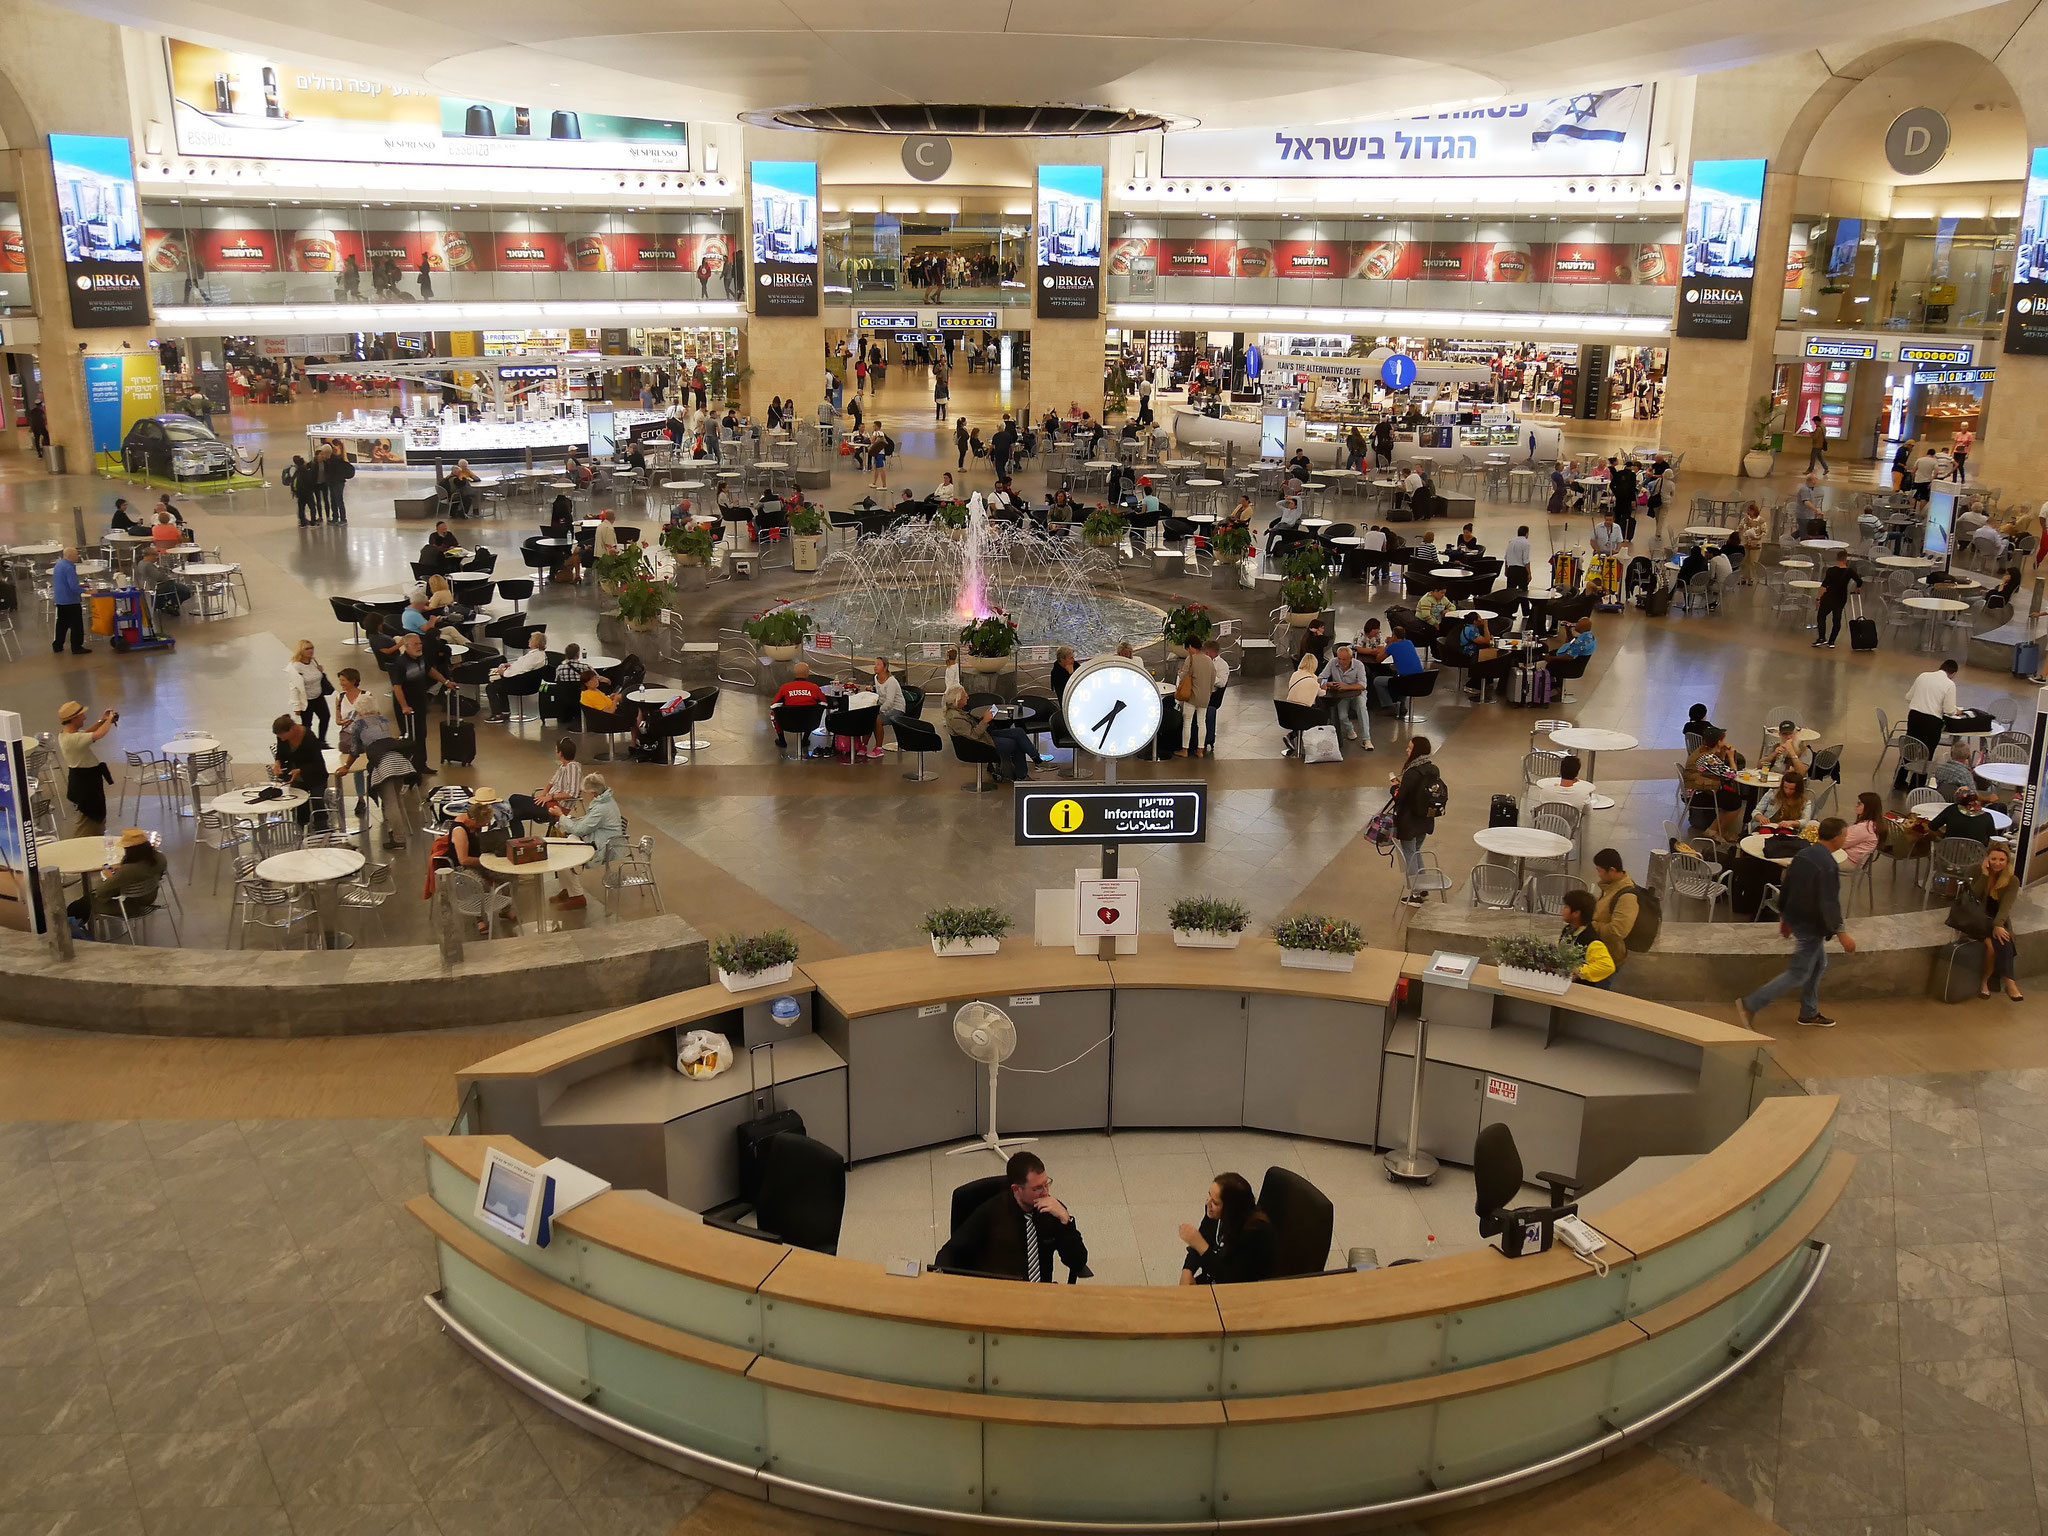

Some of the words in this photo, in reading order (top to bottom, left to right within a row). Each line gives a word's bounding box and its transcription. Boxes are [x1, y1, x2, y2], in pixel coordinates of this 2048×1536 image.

[296, 73, 343, 92] גדולים
[348, 79, 382, 98] קפה
[384, 139, 436, 150] NESPRESSO
[1275, 132, 1385, 160] בישראל
[1394, 131, 1476, 159] הגדול
[1904, 126, 1931, 156] D
[629, 148, 678, 157] NESPRESSO
[915, 142, 935, 166] C
[222, 249, 263, 257] גולדסטאר
[506, 250, 544, 258] גולדסטאר
[639, 251, 676, 259] גולדסטאר
[1173, 256, 1208, 264] גולדסטאר
[1293, 257, 1328, 266] גולדסטאר
[1423, 259, 1460, 268] גולדסטאר
[1557, 261, 1595, 270] גולדסטאר
[95, 274, 140, 286] BRIGA
[776, 273, 812, 283] BRIGA
[1058, 275, 1094, 285] BRIGA
[1703, 289, 1743, 300] BRIGA
[1957, 351, 1966, 362] D
[1296, 363, 1305, 372] THE
[1306, 364, 1343, 374] ALTERNATIVE
[1345, 367, 1361, 376] CAFE
[1110, 671, 1121, 683] 12
[1132, 676, 1137, 687] 1
[1092, 677, 1102, 689] 11
[788, 689, 812, 697] RUSSIA
[1080, 689, 1091, 700] 10
[1143, 688, 1150, 699] 2
[1072, 706, 1079, 717] 9
[1149, 705, 1156, 718] 3
[1077, 724, 1085, 735] 8
[1142, 724, 1149, 734] 4
[1092, 737, 1100, 747] 7
[1109, 743, 1116, 752] 6
[1128, 737, 1136, 747] 5
[1139, 798, 1174, 808] מודיעין
[2022, 784, 2037, 826] SAMSUNG
[1104, 808, 1174, 819] Information
[1115, 819, 1174, 831] استعلامات
[23, 820, 37, 868] SAMSUNG
[1489, 1086, 1500, 1095] אש
[1490, 1079, 1516, 1091] עמדת
